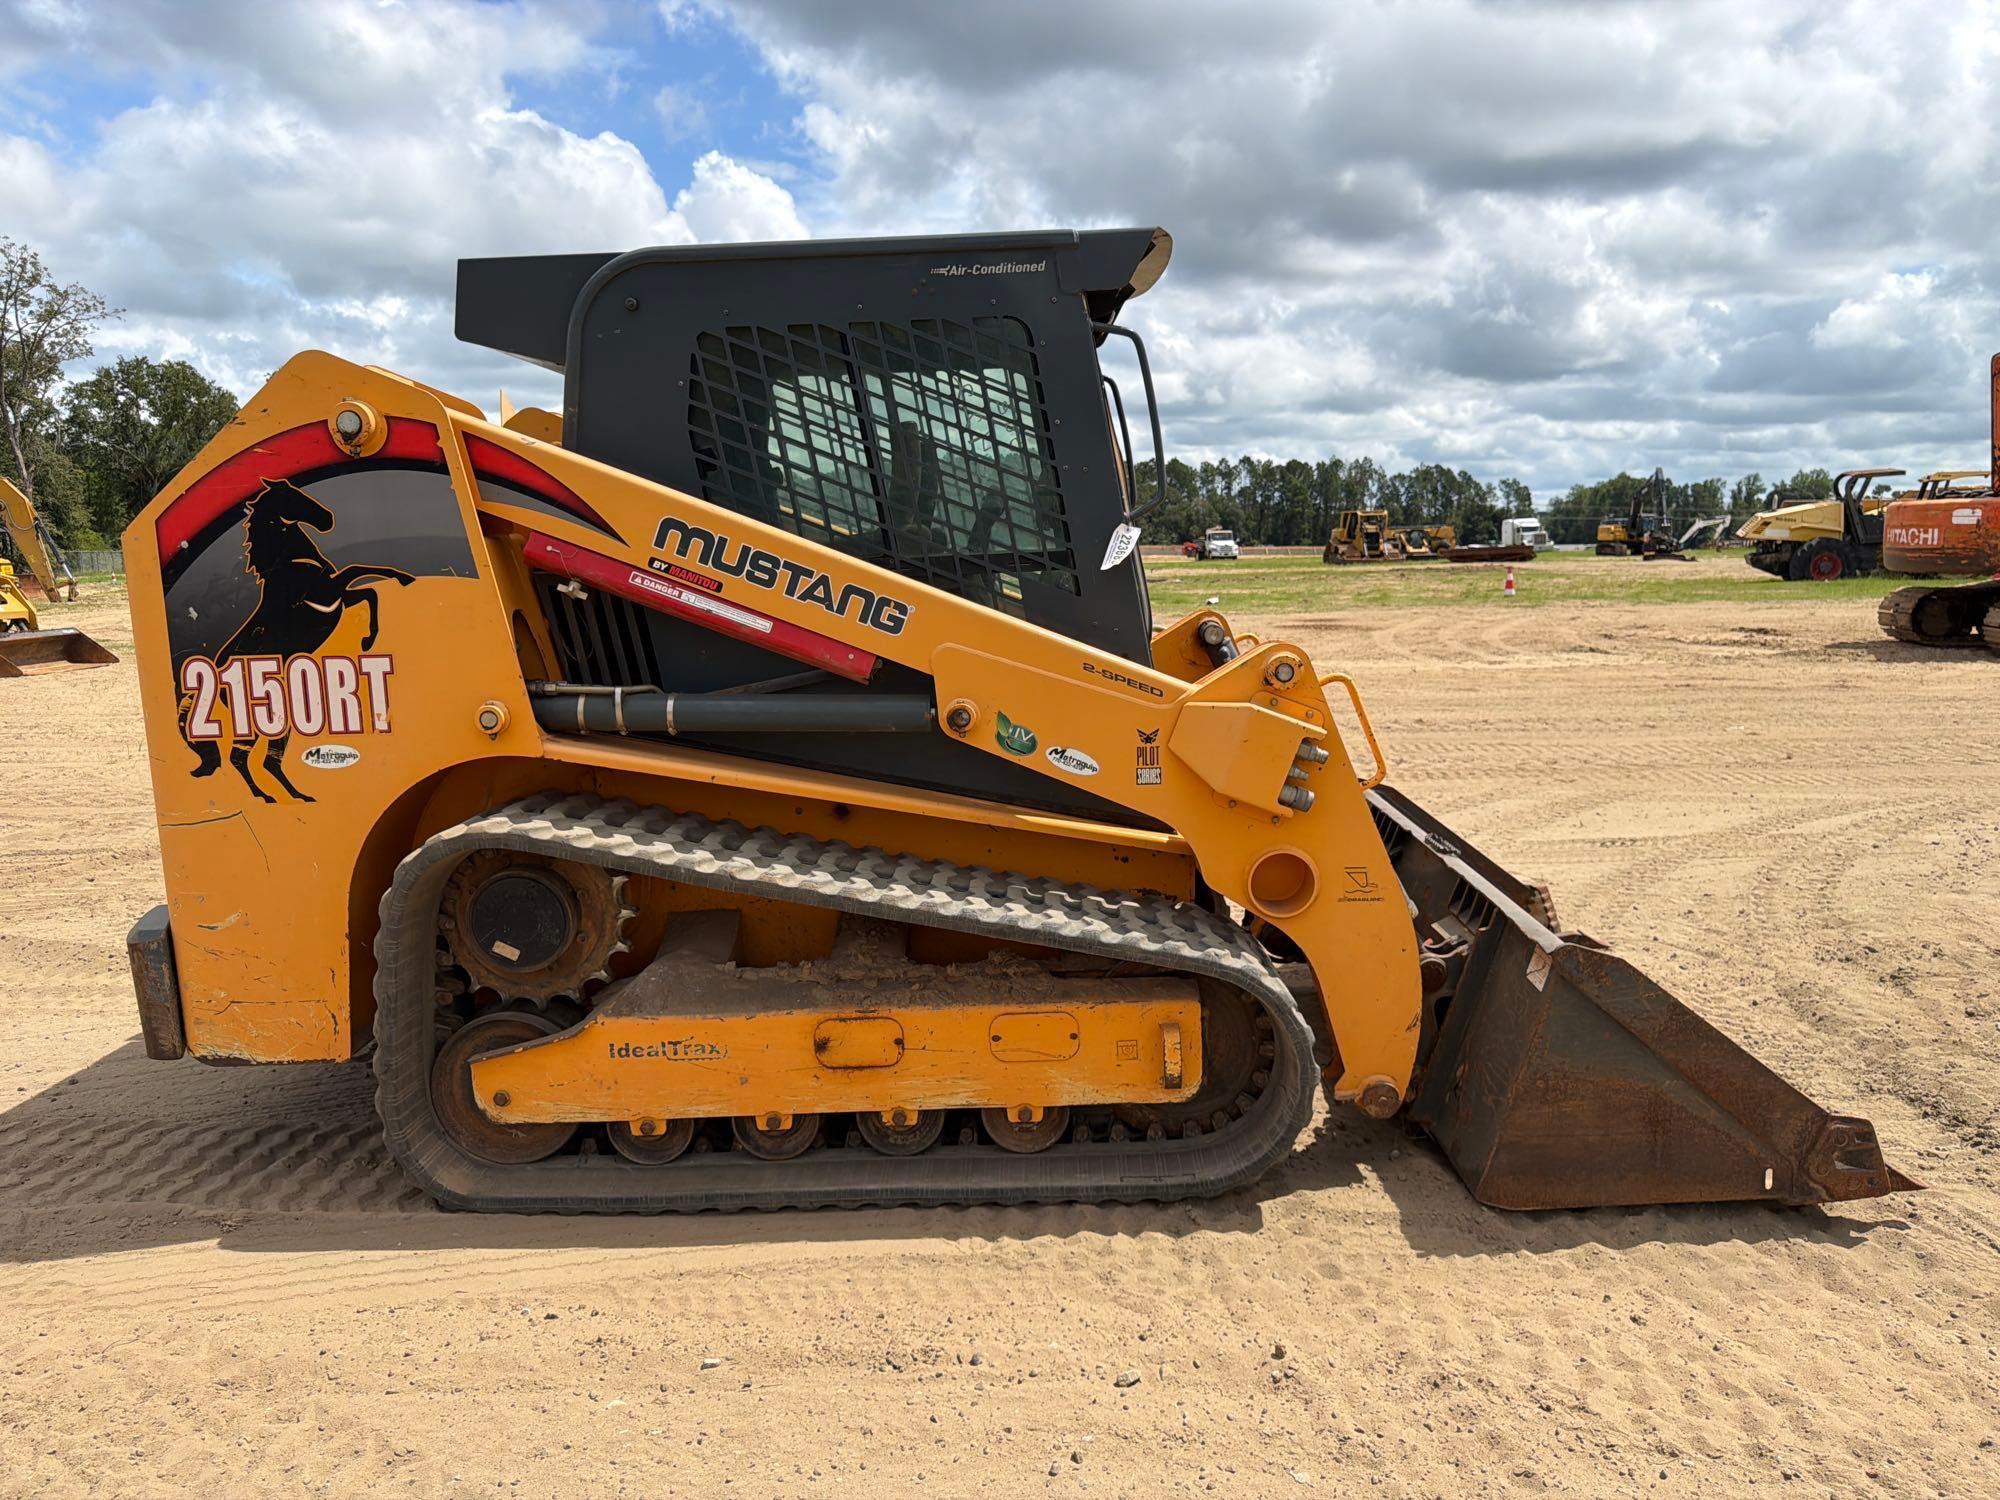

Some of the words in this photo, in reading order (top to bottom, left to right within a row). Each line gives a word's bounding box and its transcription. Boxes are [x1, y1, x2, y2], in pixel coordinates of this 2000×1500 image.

[948, 260, 1046, 276] Air-Conditioned
[1886, 527, 1939, 546] HITACHI
[652, 516, 910, 636] MUSTANG
[653, 560, 669, 571] BY
[668, 565, 719, 591] MANITOU
[643, 578, 680, 598] DANGER
[1082, 662, 1164, 698] 2-SPEED
[184, 654, 394, 738] 2150RT
[305, 747, 359, 761] Metroquip
[1048, 748, 1098, 772] Metroquip
[1136, 745, 1160, 766] PILOT
[609, 1040, 721, 1058] IdealTrax
